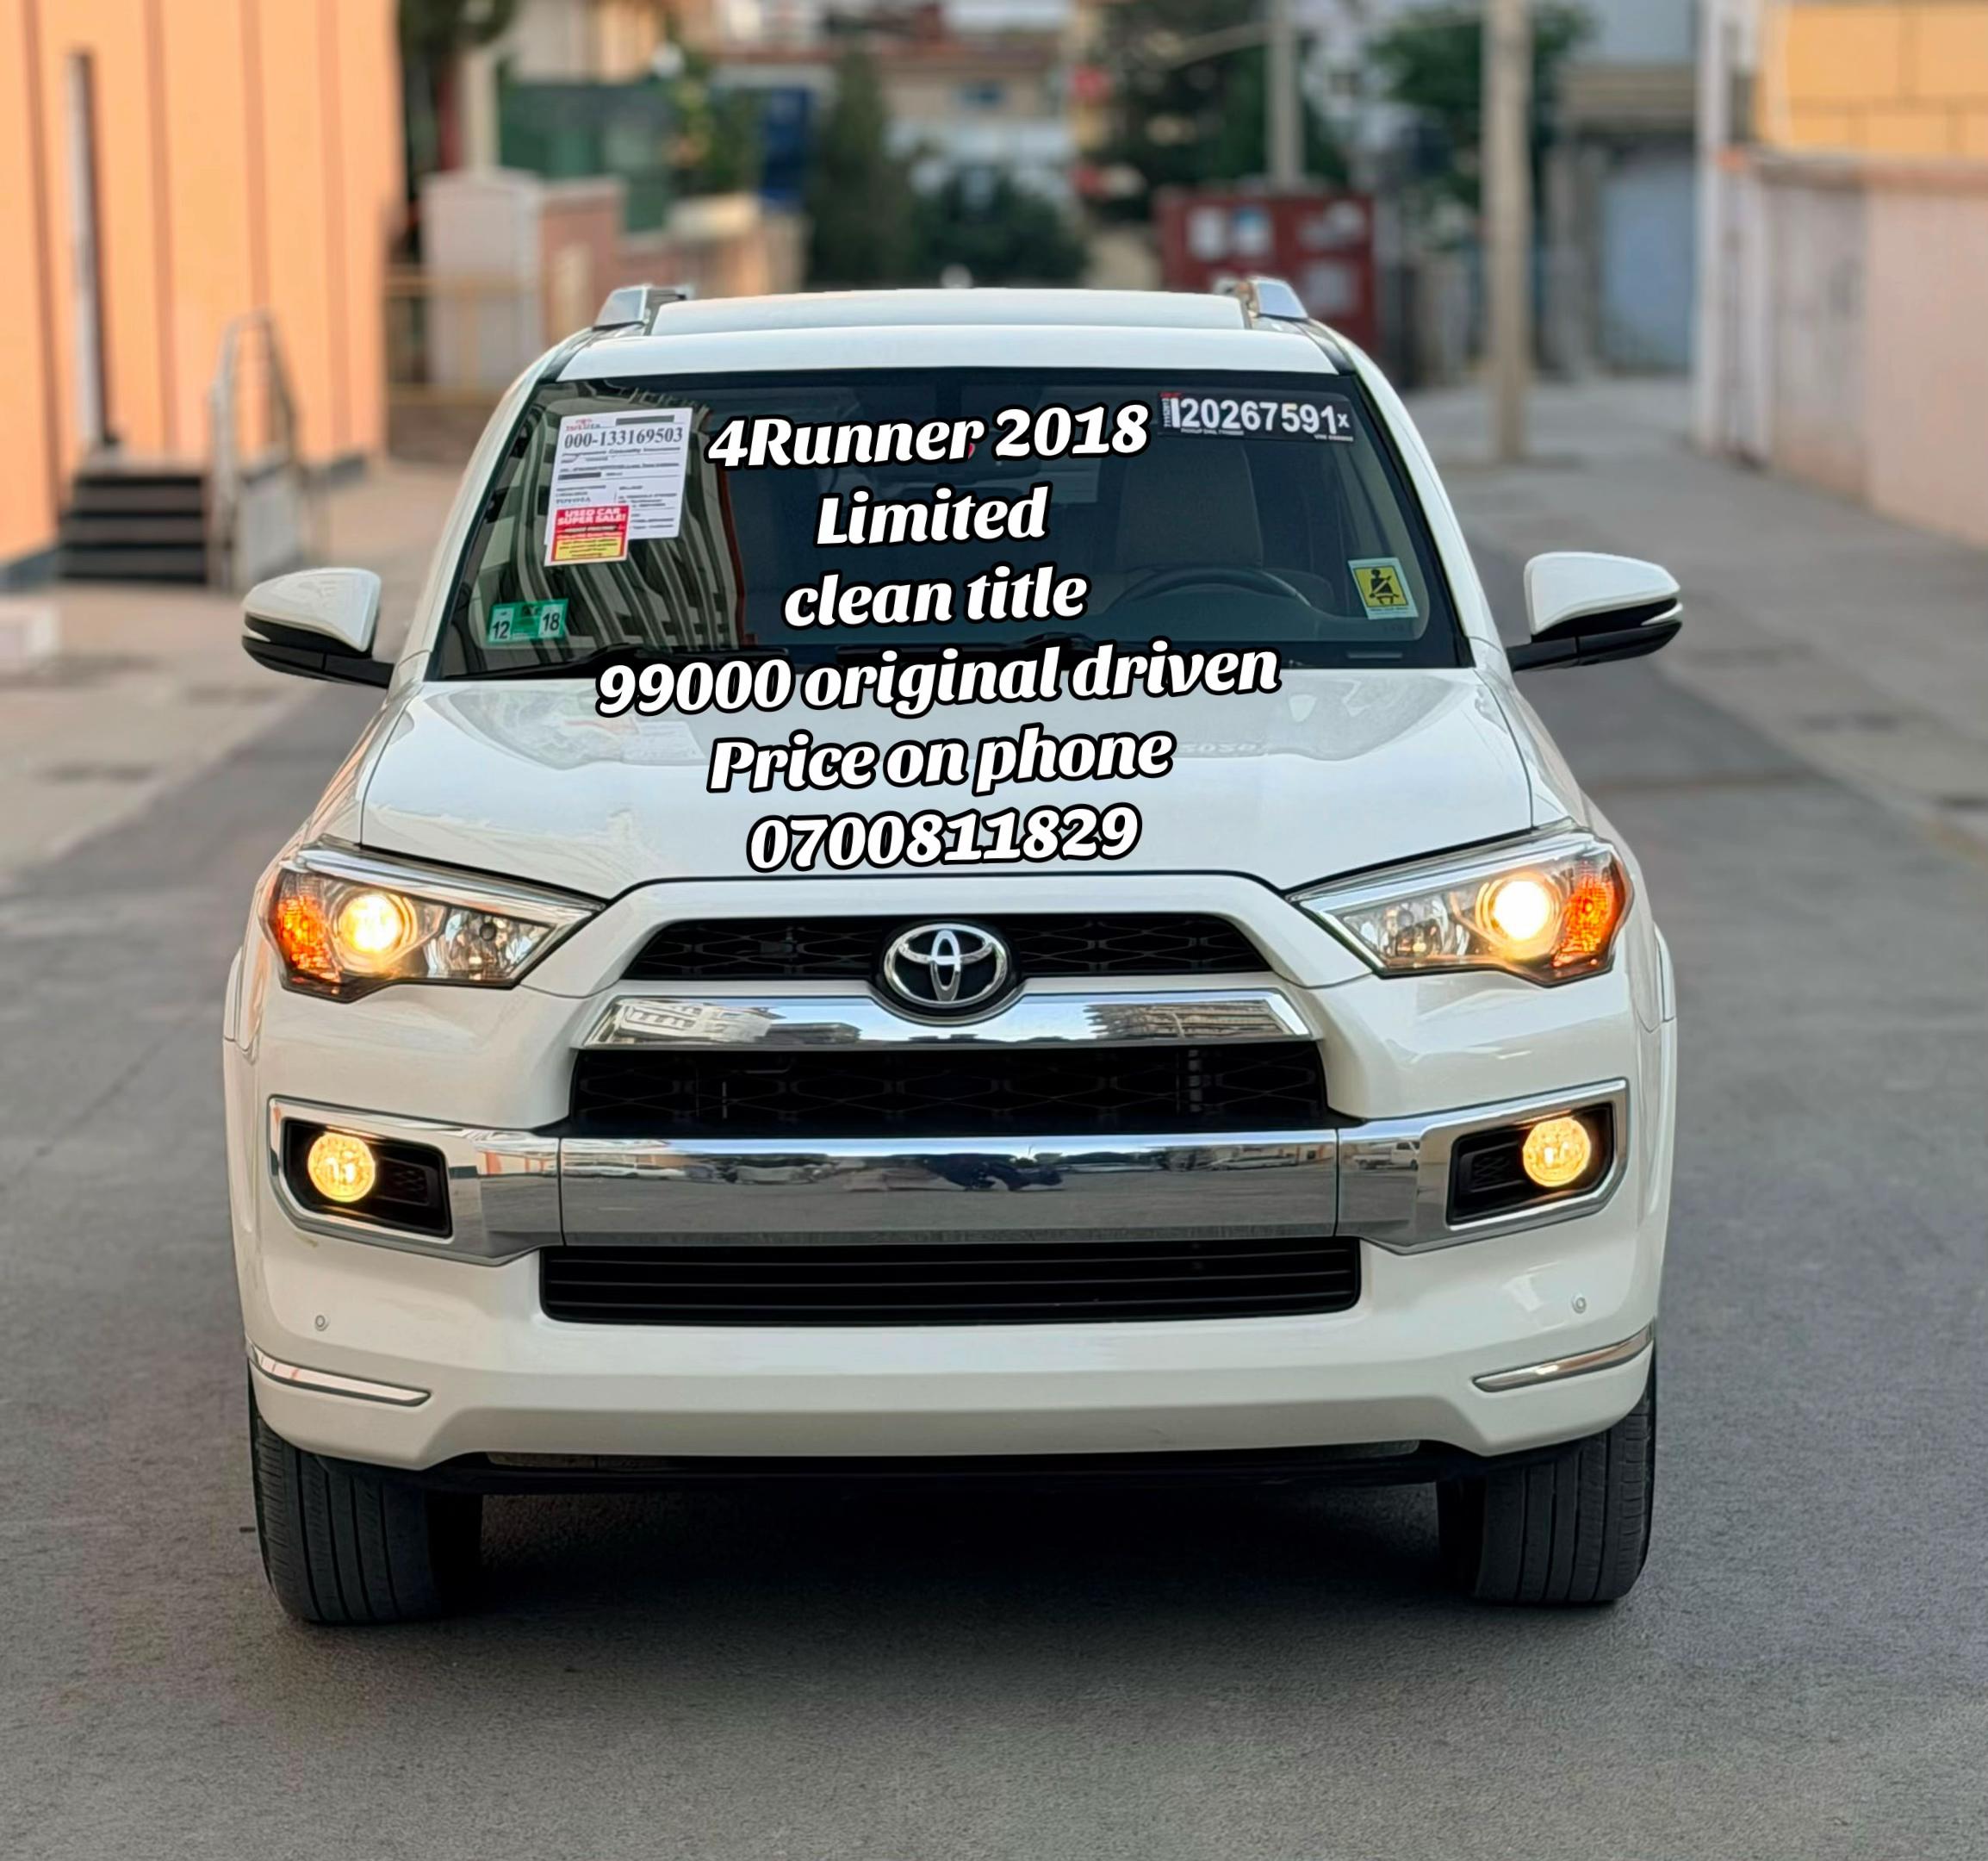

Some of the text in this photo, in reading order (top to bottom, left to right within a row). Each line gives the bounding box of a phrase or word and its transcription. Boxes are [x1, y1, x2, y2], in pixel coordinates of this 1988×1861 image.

[564, 426, 683, 448] 000-133169503
[557, 516, 593, 526] SUPER
[492, 620, 511, 639] 12
[543, 612, 561, 632] 18
